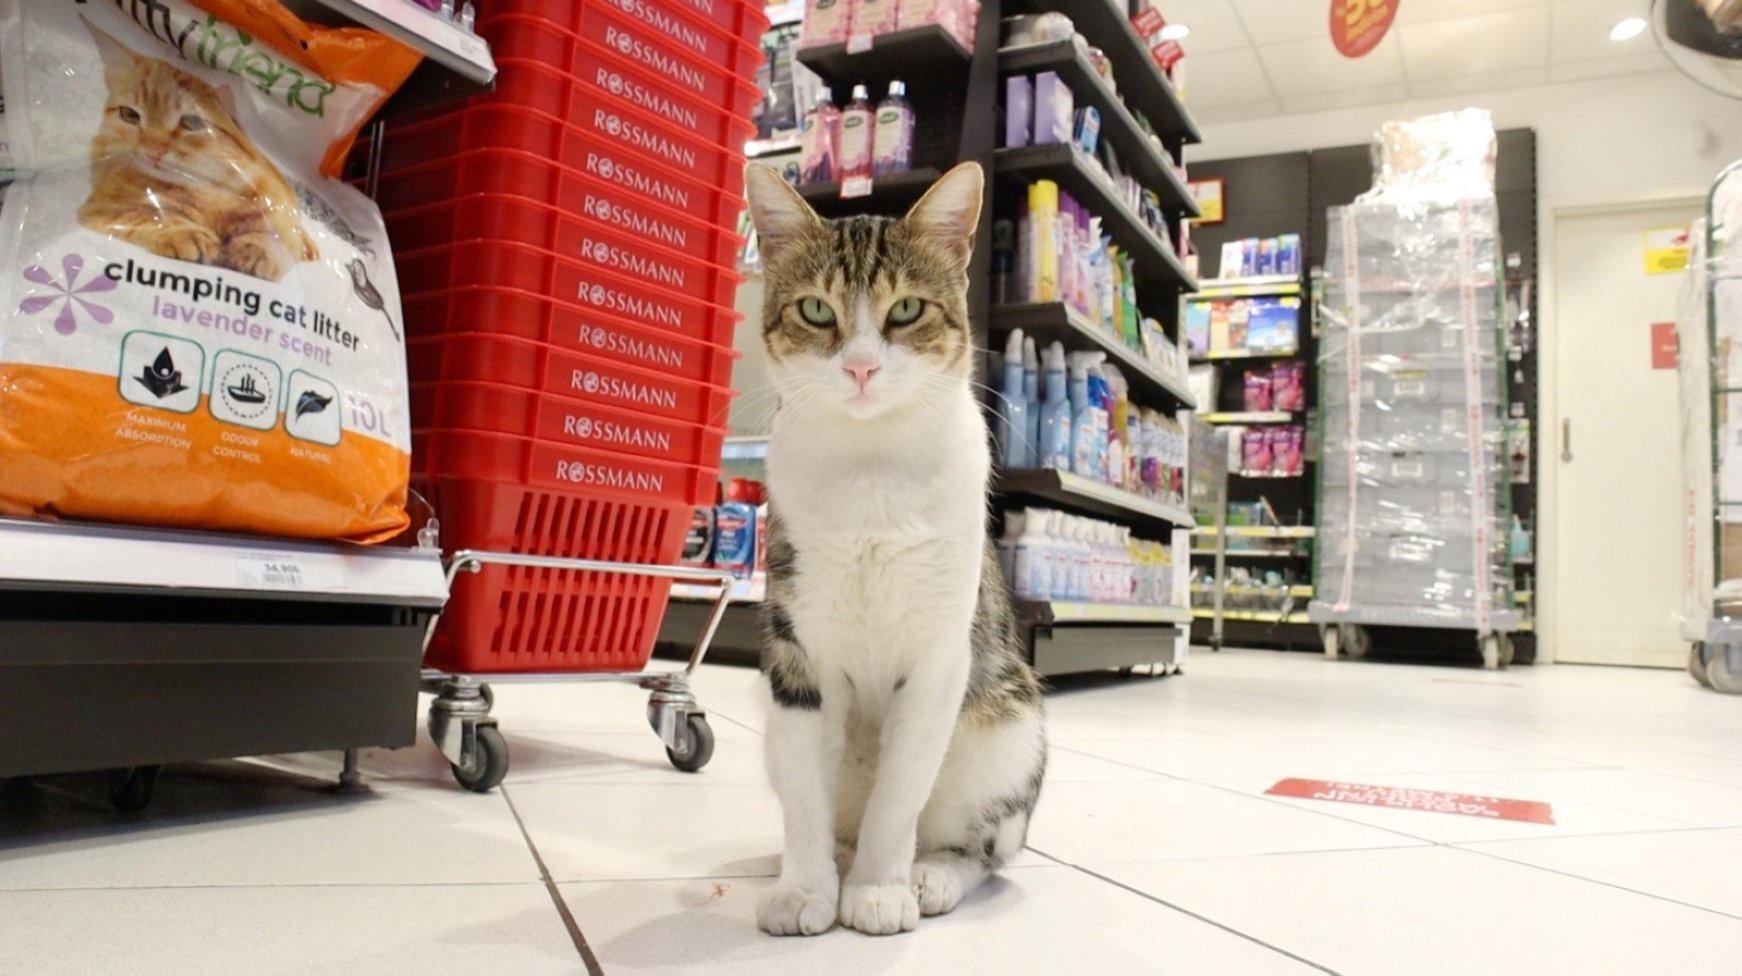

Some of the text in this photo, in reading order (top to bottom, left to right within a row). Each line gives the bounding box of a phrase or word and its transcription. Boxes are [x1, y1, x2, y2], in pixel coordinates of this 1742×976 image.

[608, 0, 706, 53] OSSMANN
[605, 26, 704, 91] ROSSMANN
[596, 67, 696, 129] ROSSMANN
[594, 109, 695, 168] ROSSMANN
[586, 152, 688, 208] ROSSMANN
[583, 194, 685, 247] ROSSMANN
[581, 237, 683, 287] ROSSMANN
[104, 259, 360, 352] clumping cat litter
[577, 281, 680, 327] ROSSMANN
[153, 295, 332, 367] lavender scent
[579, 324, 682, 368] ROSSMANN
[571, 369, 675, 409] ROSSMANN
[115, 427, 192, 449] ABSORPTION
[126, 411, 187, 433] MAXIMUM
[348, 394, 392, 438] 10L
[564, 415, 669, 450] ROSSMANN
[213, 445, 261, 464] CONTROL
[221, 431, 260, 447] ODOUR
[290, 447, 332, 464] NATURAL
[556, 460, 662, 491] ROSSMANN
